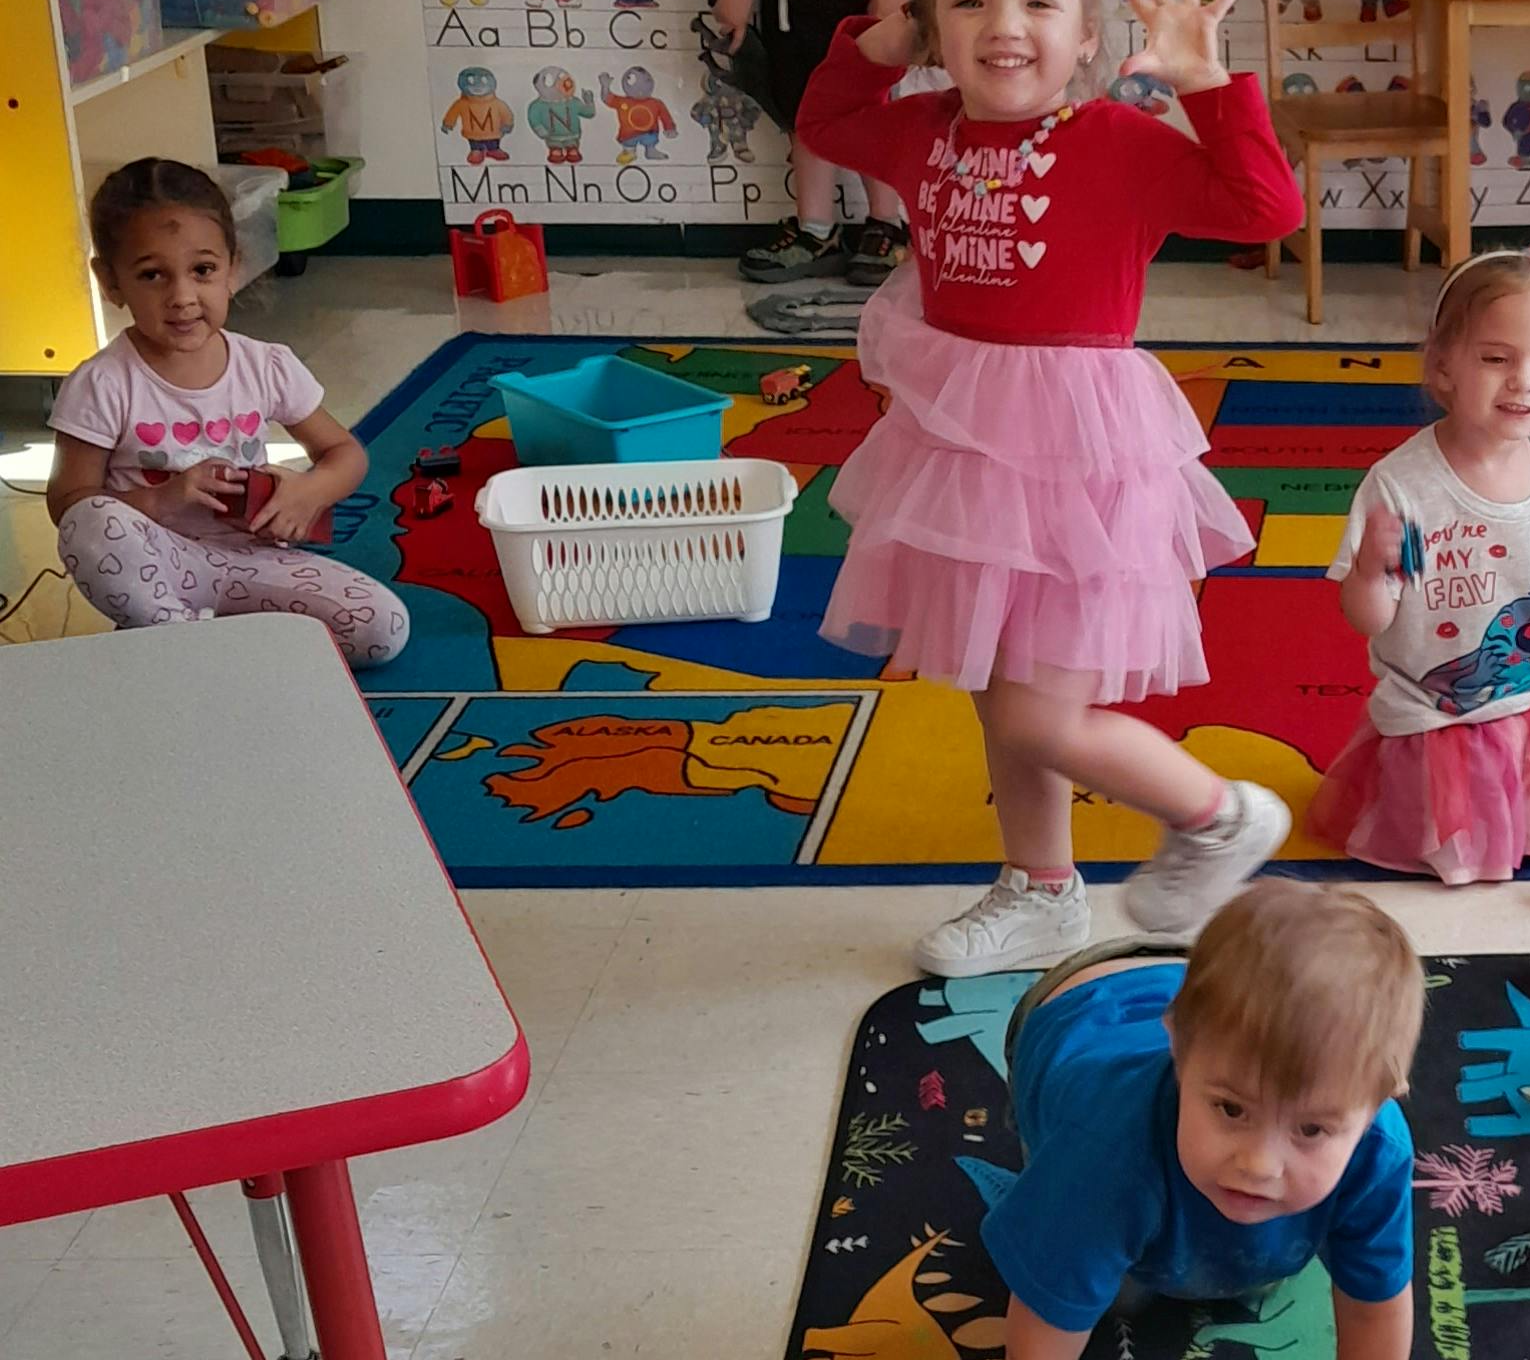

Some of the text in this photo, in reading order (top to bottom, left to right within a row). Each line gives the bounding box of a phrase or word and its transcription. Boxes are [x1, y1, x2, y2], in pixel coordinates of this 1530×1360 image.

[436, 8, 668, 50] Aa Bb Cc
[468, 109, 495, 132] M
[549, 107, 572, 134] N
[451, 165, 761, 220] Mm Nn Oo Pp
[918, 180, 937, 214] BE
[1358, 170, 1405, 209] Xx
[932, 208, 1019, 242] Valentine
[918, 226, 937, 261] BE
[932, 254, 1019, 292] Valentine
[1436, 549, 1472, 571] MY
[1424, 571, 1498, 610] FAV
[553, 725, 673, 738] ALASKA
[709, 734, 834, 747] CANADA
